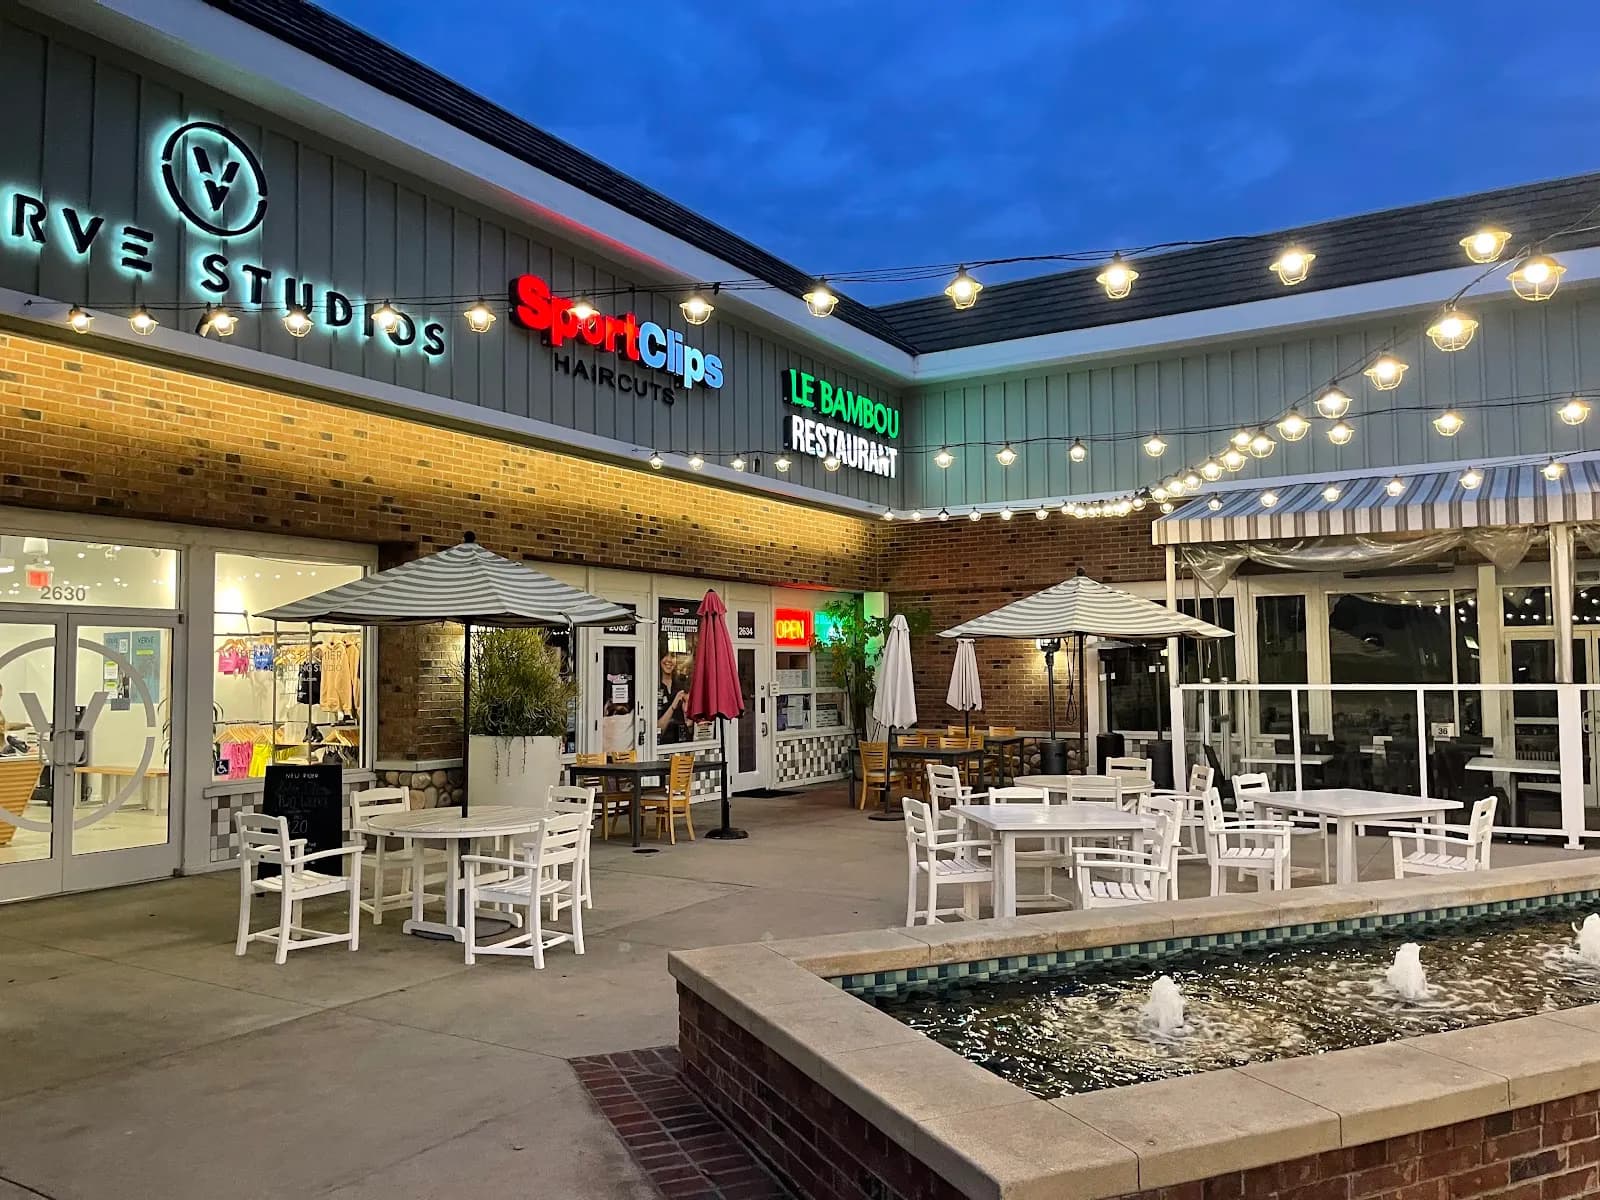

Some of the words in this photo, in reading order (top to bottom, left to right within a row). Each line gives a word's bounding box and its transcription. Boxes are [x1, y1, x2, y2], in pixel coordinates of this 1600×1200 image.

[200, 253, 446, 357] STUDIOS
[553, 352, 676, 406] HAIRCUTS
[789, 368, 815, 408] LE
[819, 380, 899, 439] BAMBOU
[791, 414, 898, 479] RESTAURANT
[40, 585, 86, 601] 2630
[738, 626, 754, 636] 2634
[775, 620, 805, 639] OPEN
